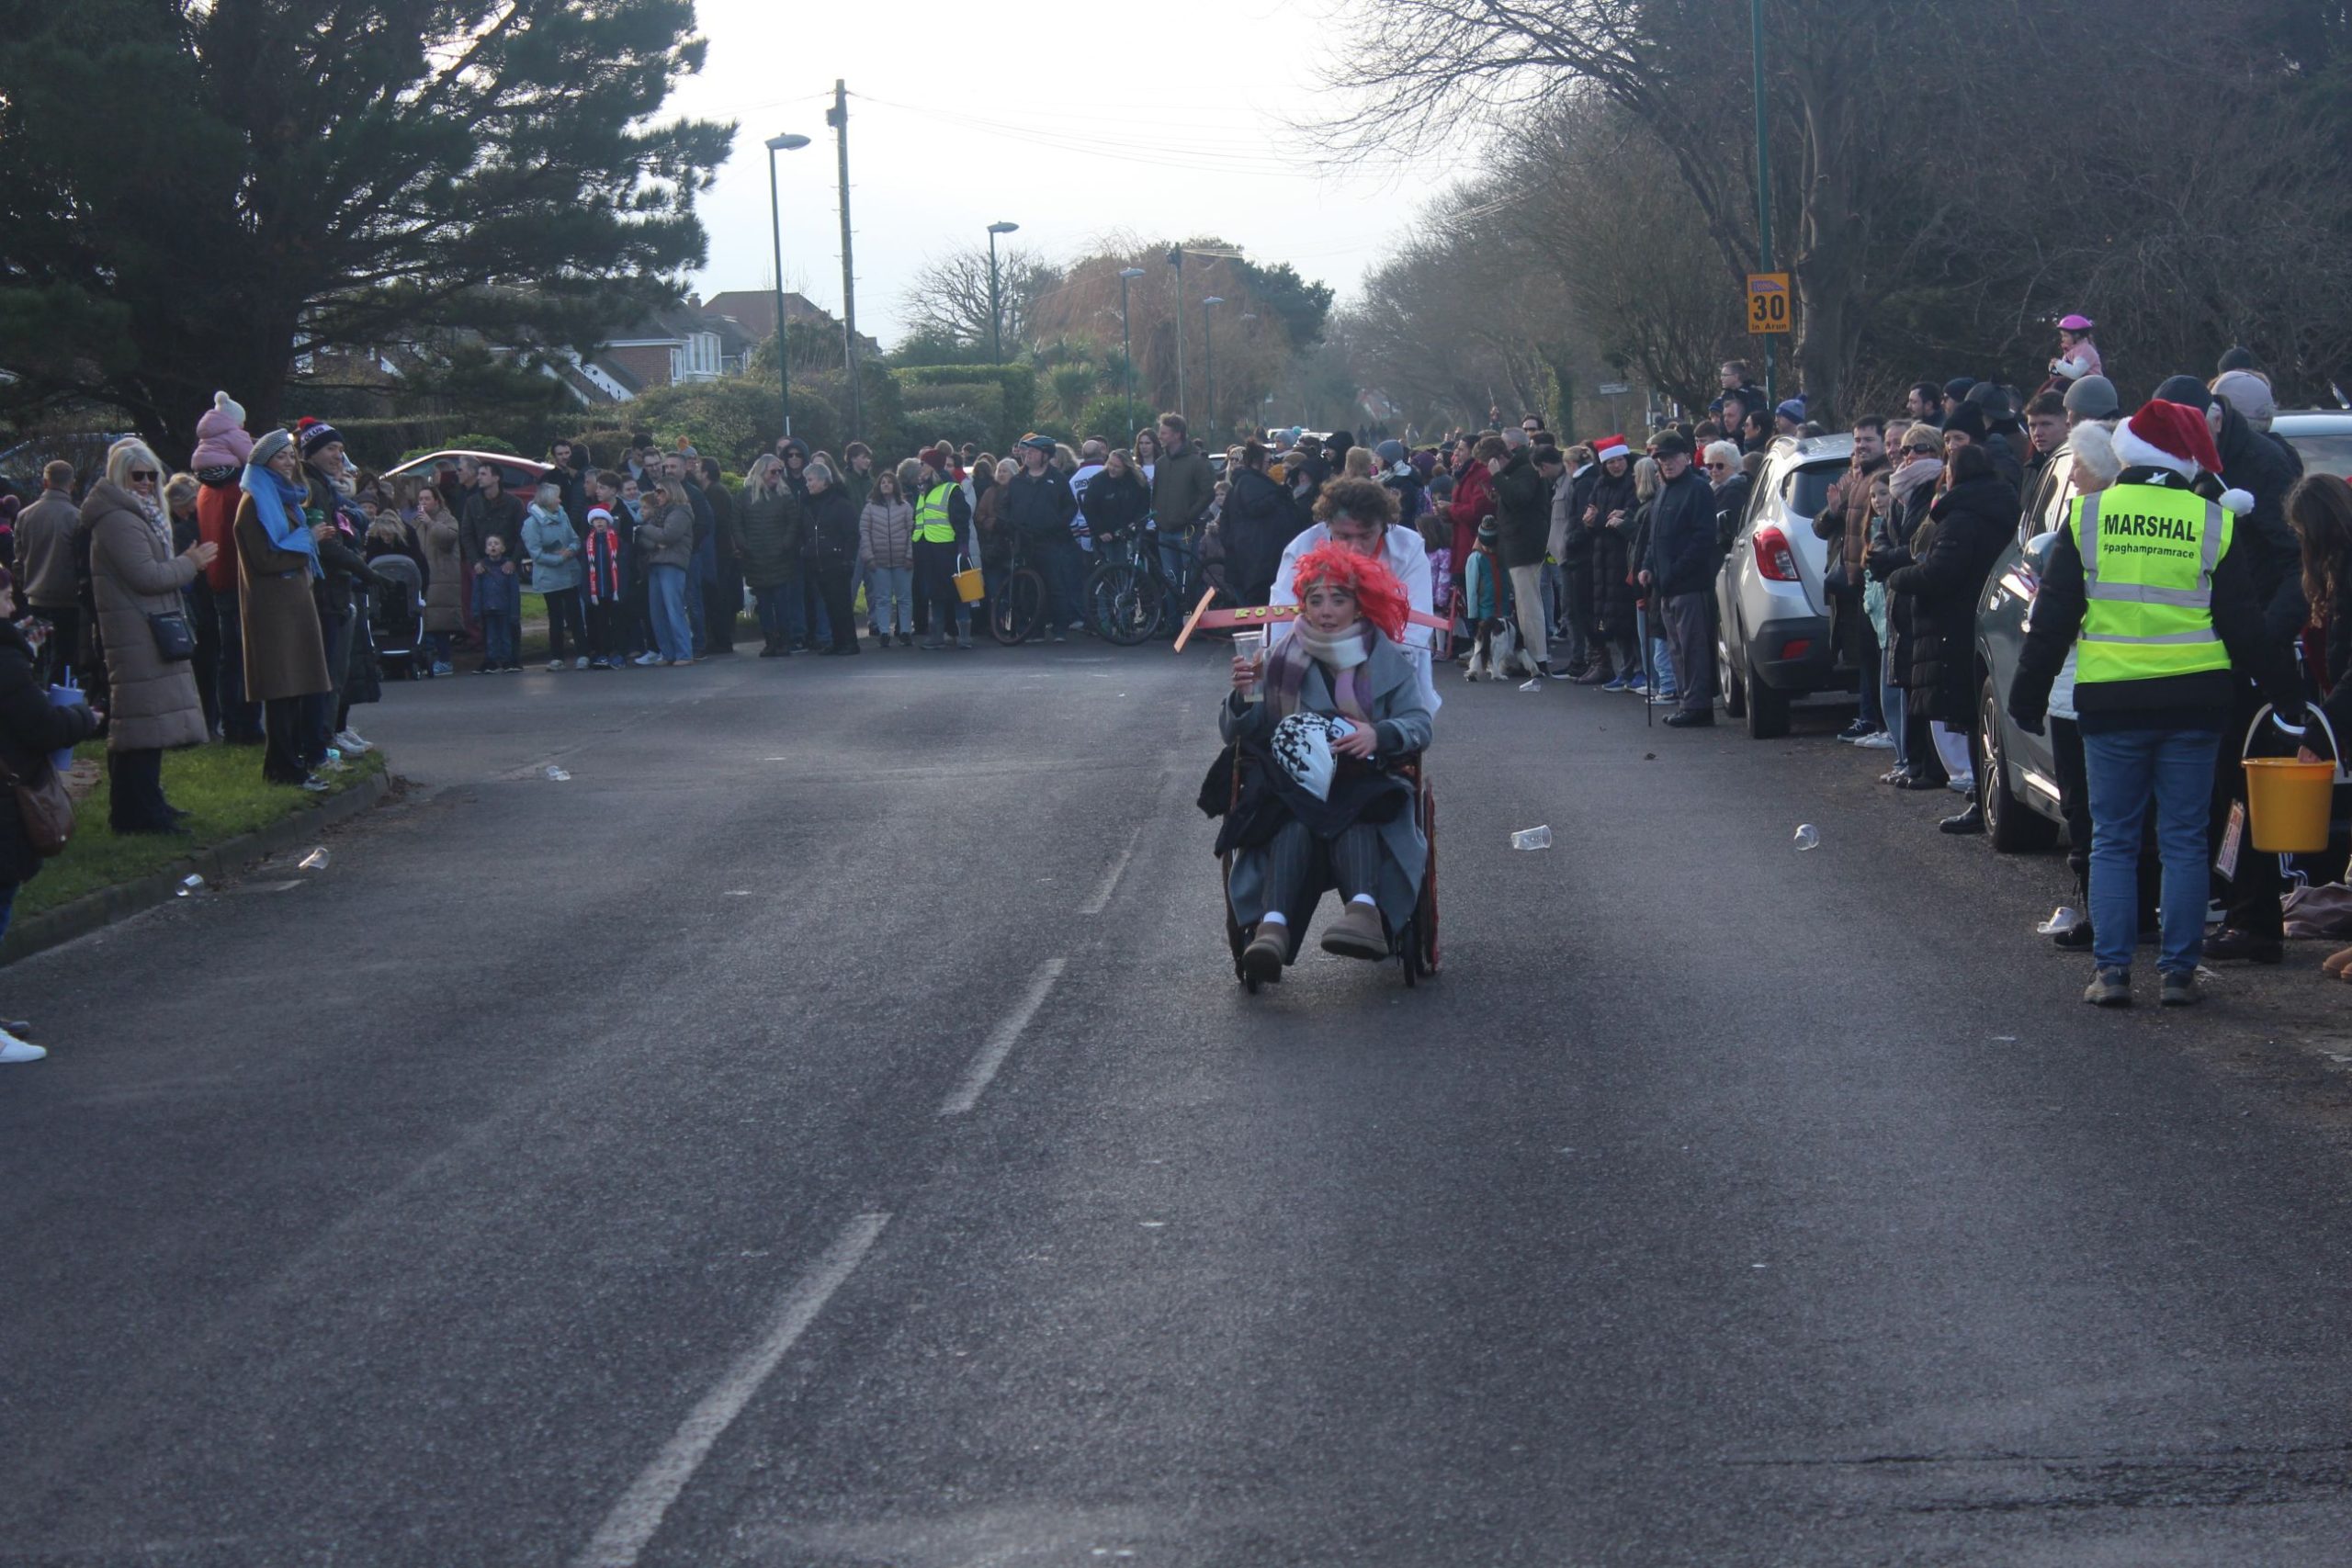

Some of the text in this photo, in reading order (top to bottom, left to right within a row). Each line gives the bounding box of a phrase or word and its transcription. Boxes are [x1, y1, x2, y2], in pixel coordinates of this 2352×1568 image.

[1753, 295, 1785, 321] 30
[1764, 322, 1787, 331] Arun
[2104, 513, 2197, 542] MARSHAL
[2103, 542, 2195, 559] #paghampramrace
